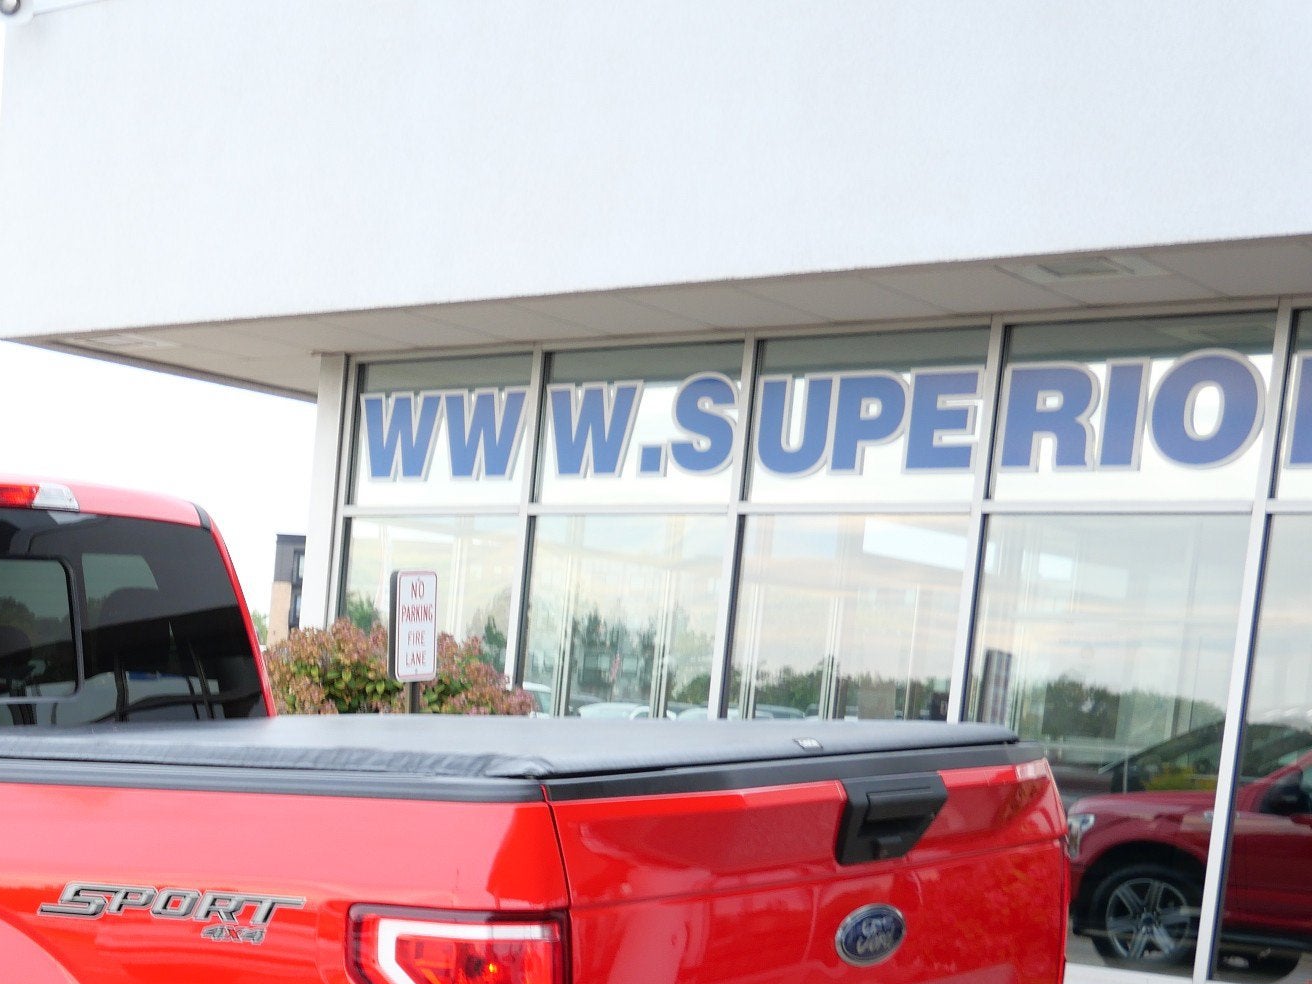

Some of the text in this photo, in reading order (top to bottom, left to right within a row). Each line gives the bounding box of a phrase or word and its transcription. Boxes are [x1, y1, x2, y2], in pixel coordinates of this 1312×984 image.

[358, 347, 1312, 482] WWW.SUPERIO
[411, 580, 425, 599] NO
[401, 603, 433, 624] PARKING
[407, 630, 426, 646] FIRE
[406, 650, 426, 667] LANE
[38, 881, 307, 925] SPORT
